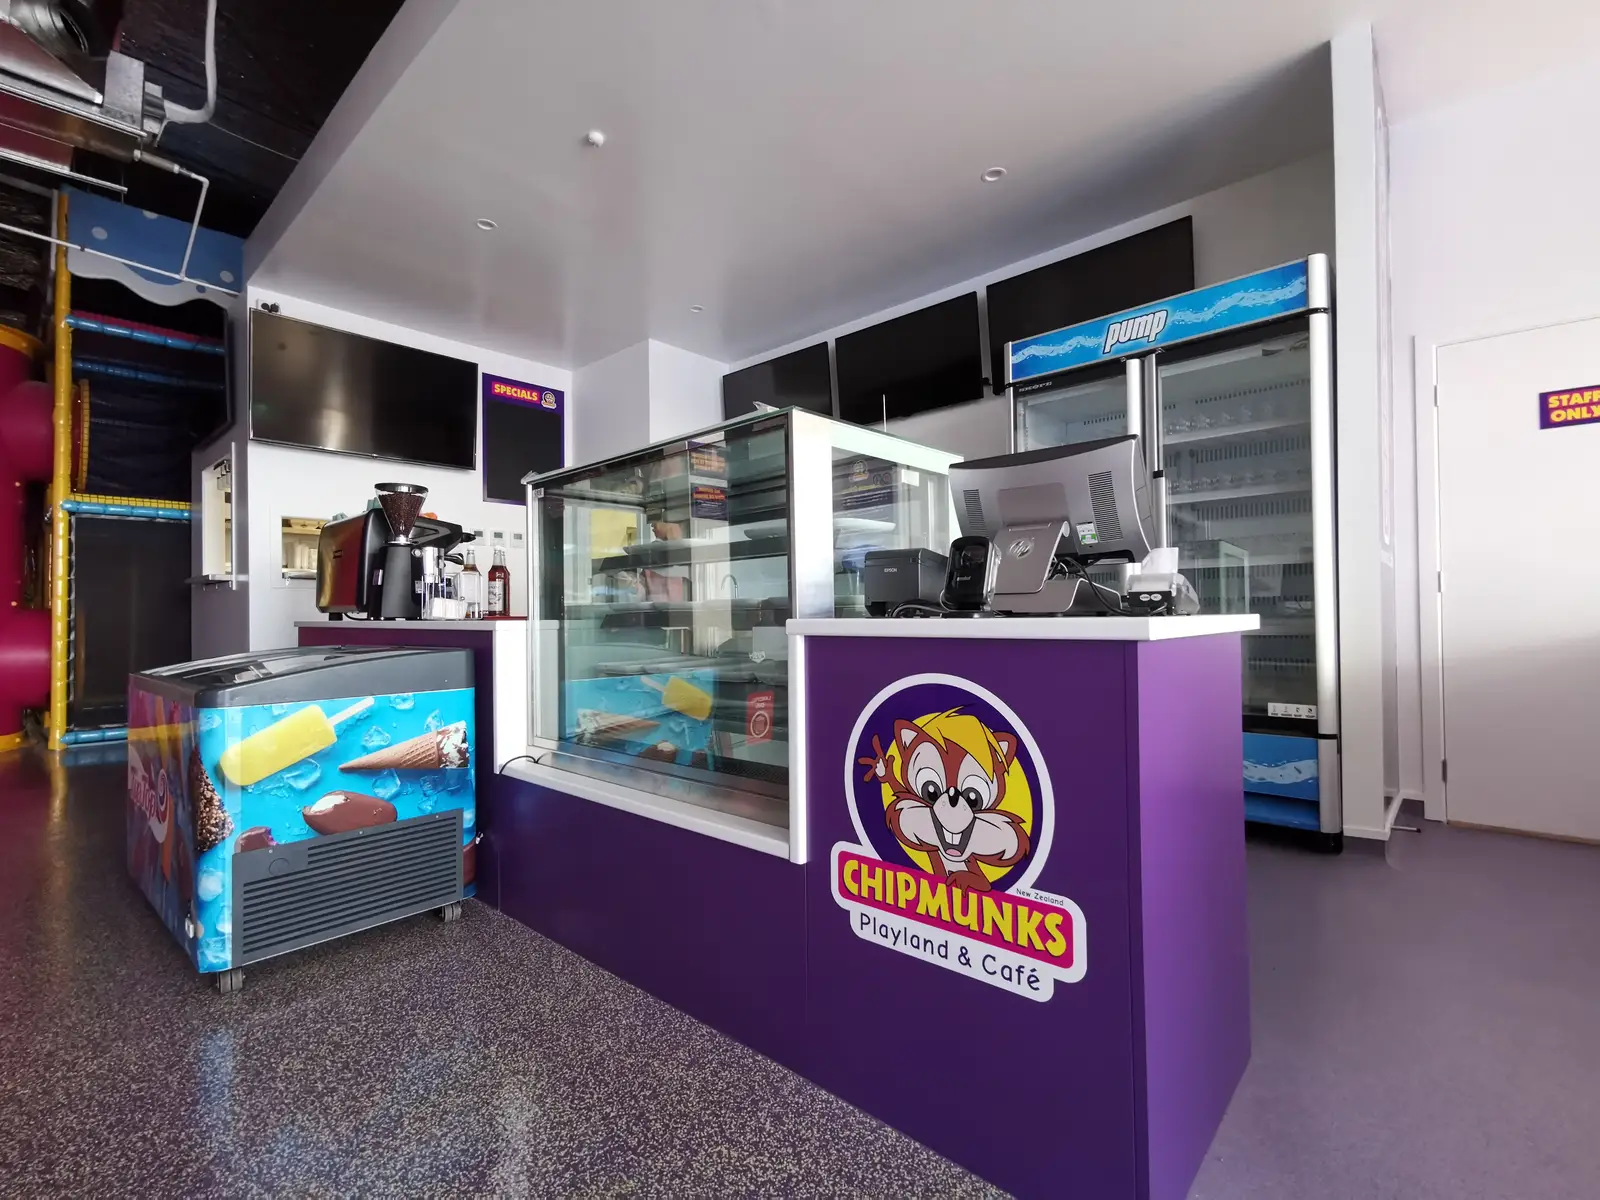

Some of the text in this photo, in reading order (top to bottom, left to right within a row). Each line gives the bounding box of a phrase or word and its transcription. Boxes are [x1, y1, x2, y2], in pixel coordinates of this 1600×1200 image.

[1103, 309, 1168, 354] pump
[494, 383, 538, 401] SPECIALS
[1548, 390, 1600, 408] STAFF
[1551, 406, 1600, 422] ONLY
[1015, 888, 1064, 906] New Zealand
[843, 860, 1067, 957] CHIPMUNKS
[860, 913, 1040, 991] Playland & Café
